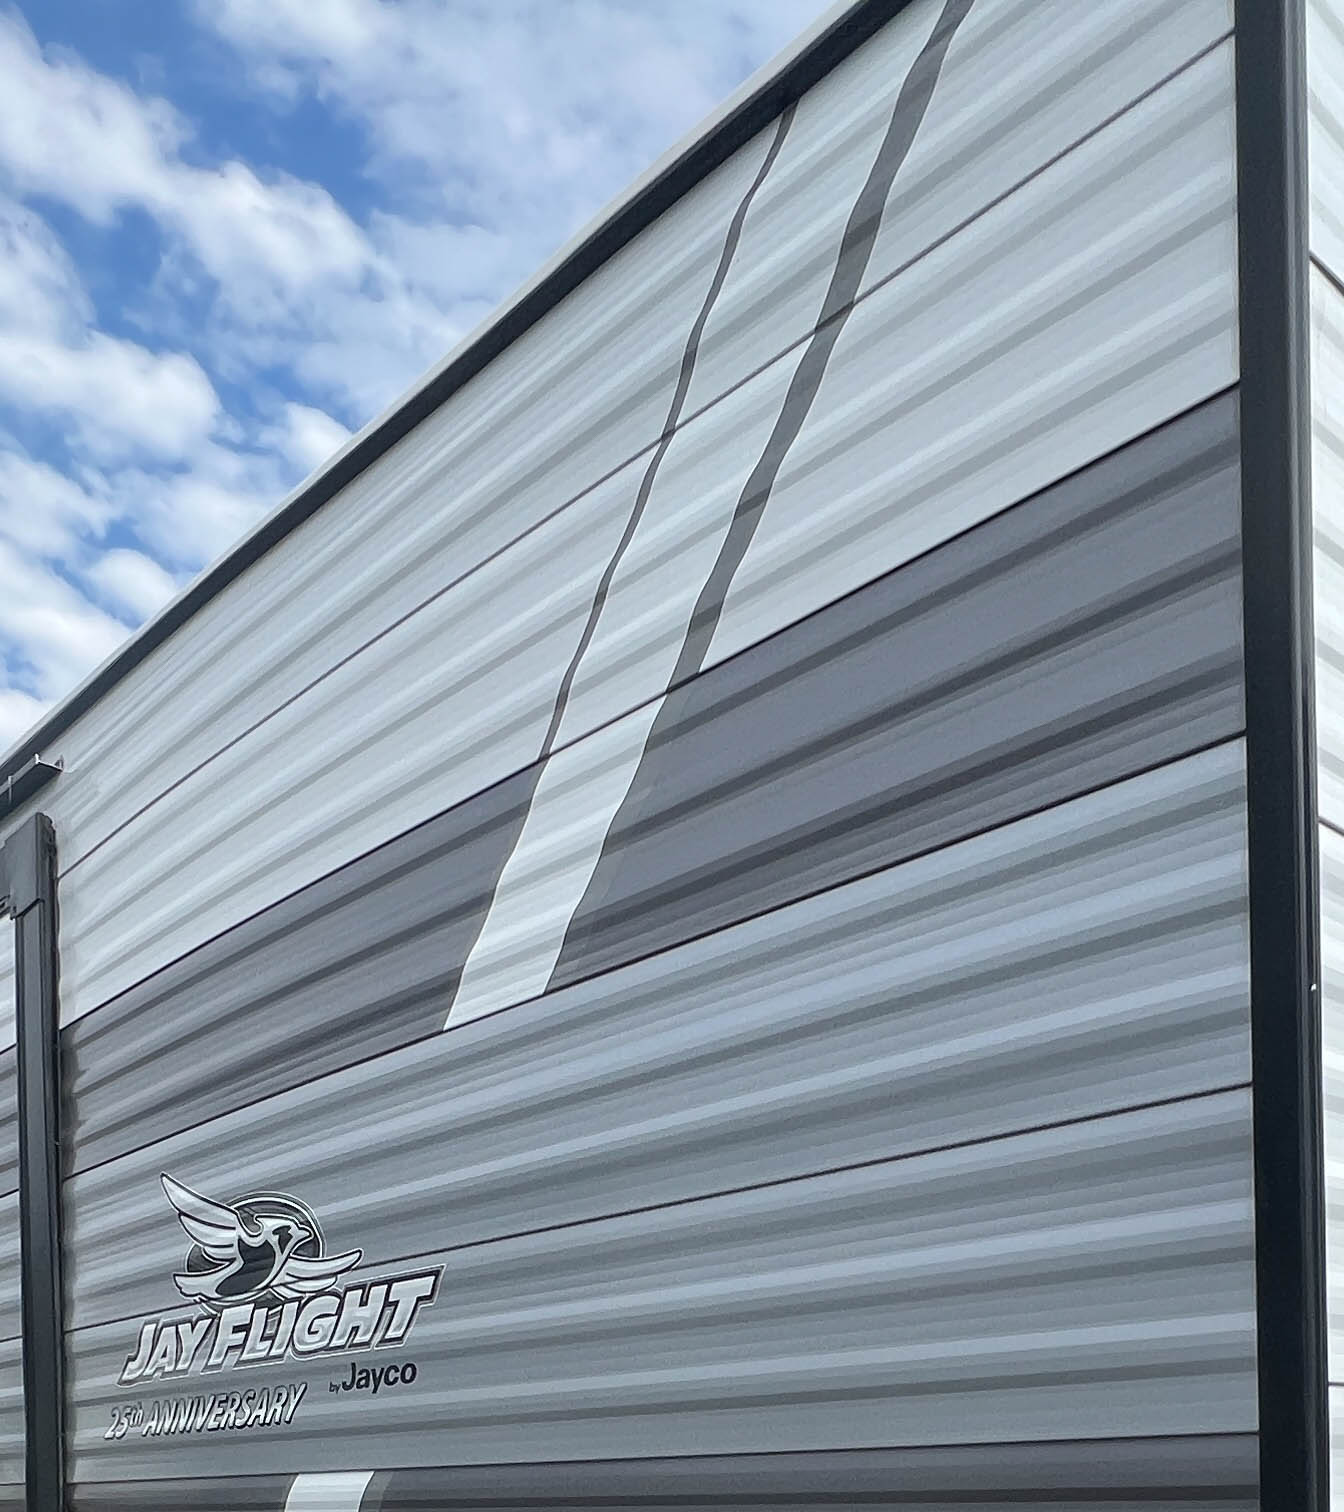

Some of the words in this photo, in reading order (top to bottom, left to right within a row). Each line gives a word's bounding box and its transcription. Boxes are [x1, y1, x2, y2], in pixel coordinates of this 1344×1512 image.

[120, 1316, 214, 1385] JAY
[204, 1272, 441, 1369] FLIGHT
[342, 1361, 417, 1394] Jayco
[104, 1402, 143, 1440] 25th
[143, 1383, 307, 1437] ANNIVERSARY
